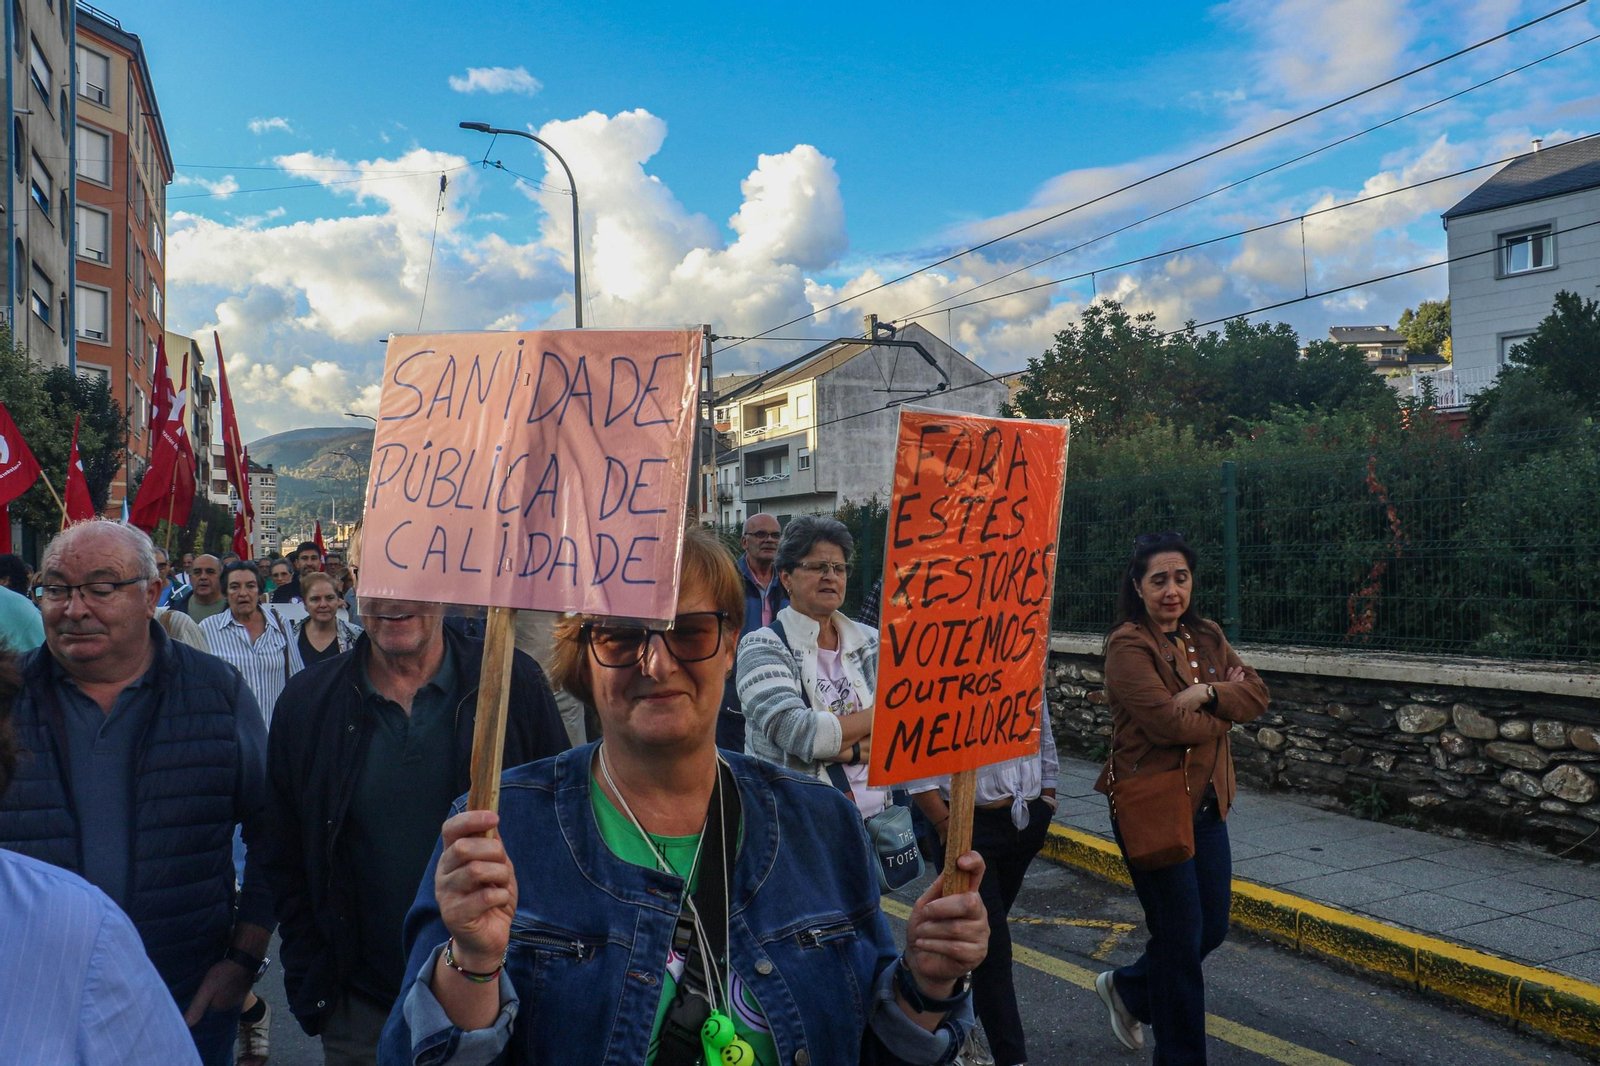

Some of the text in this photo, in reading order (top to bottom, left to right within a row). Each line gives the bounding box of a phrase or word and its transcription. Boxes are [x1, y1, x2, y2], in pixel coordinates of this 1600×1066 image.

[381, 339, 682, 428] SANIDADE
[371, 440, 668, 520] PÚBLICA DE
[913, 425, 1029, 491] FORA
[893, 492, 1029, 549] ESTES
[384, 521, 660, 587] CALIDADE
[891, 543, 1055, 611] XESTORES
[888, 609, 1040, 667] VOTEMOS
[885, 668, 1003, 710] OUTROS
[884, 686, 1041, 773] MELLORES
[899, 829, 913, 843] THE
